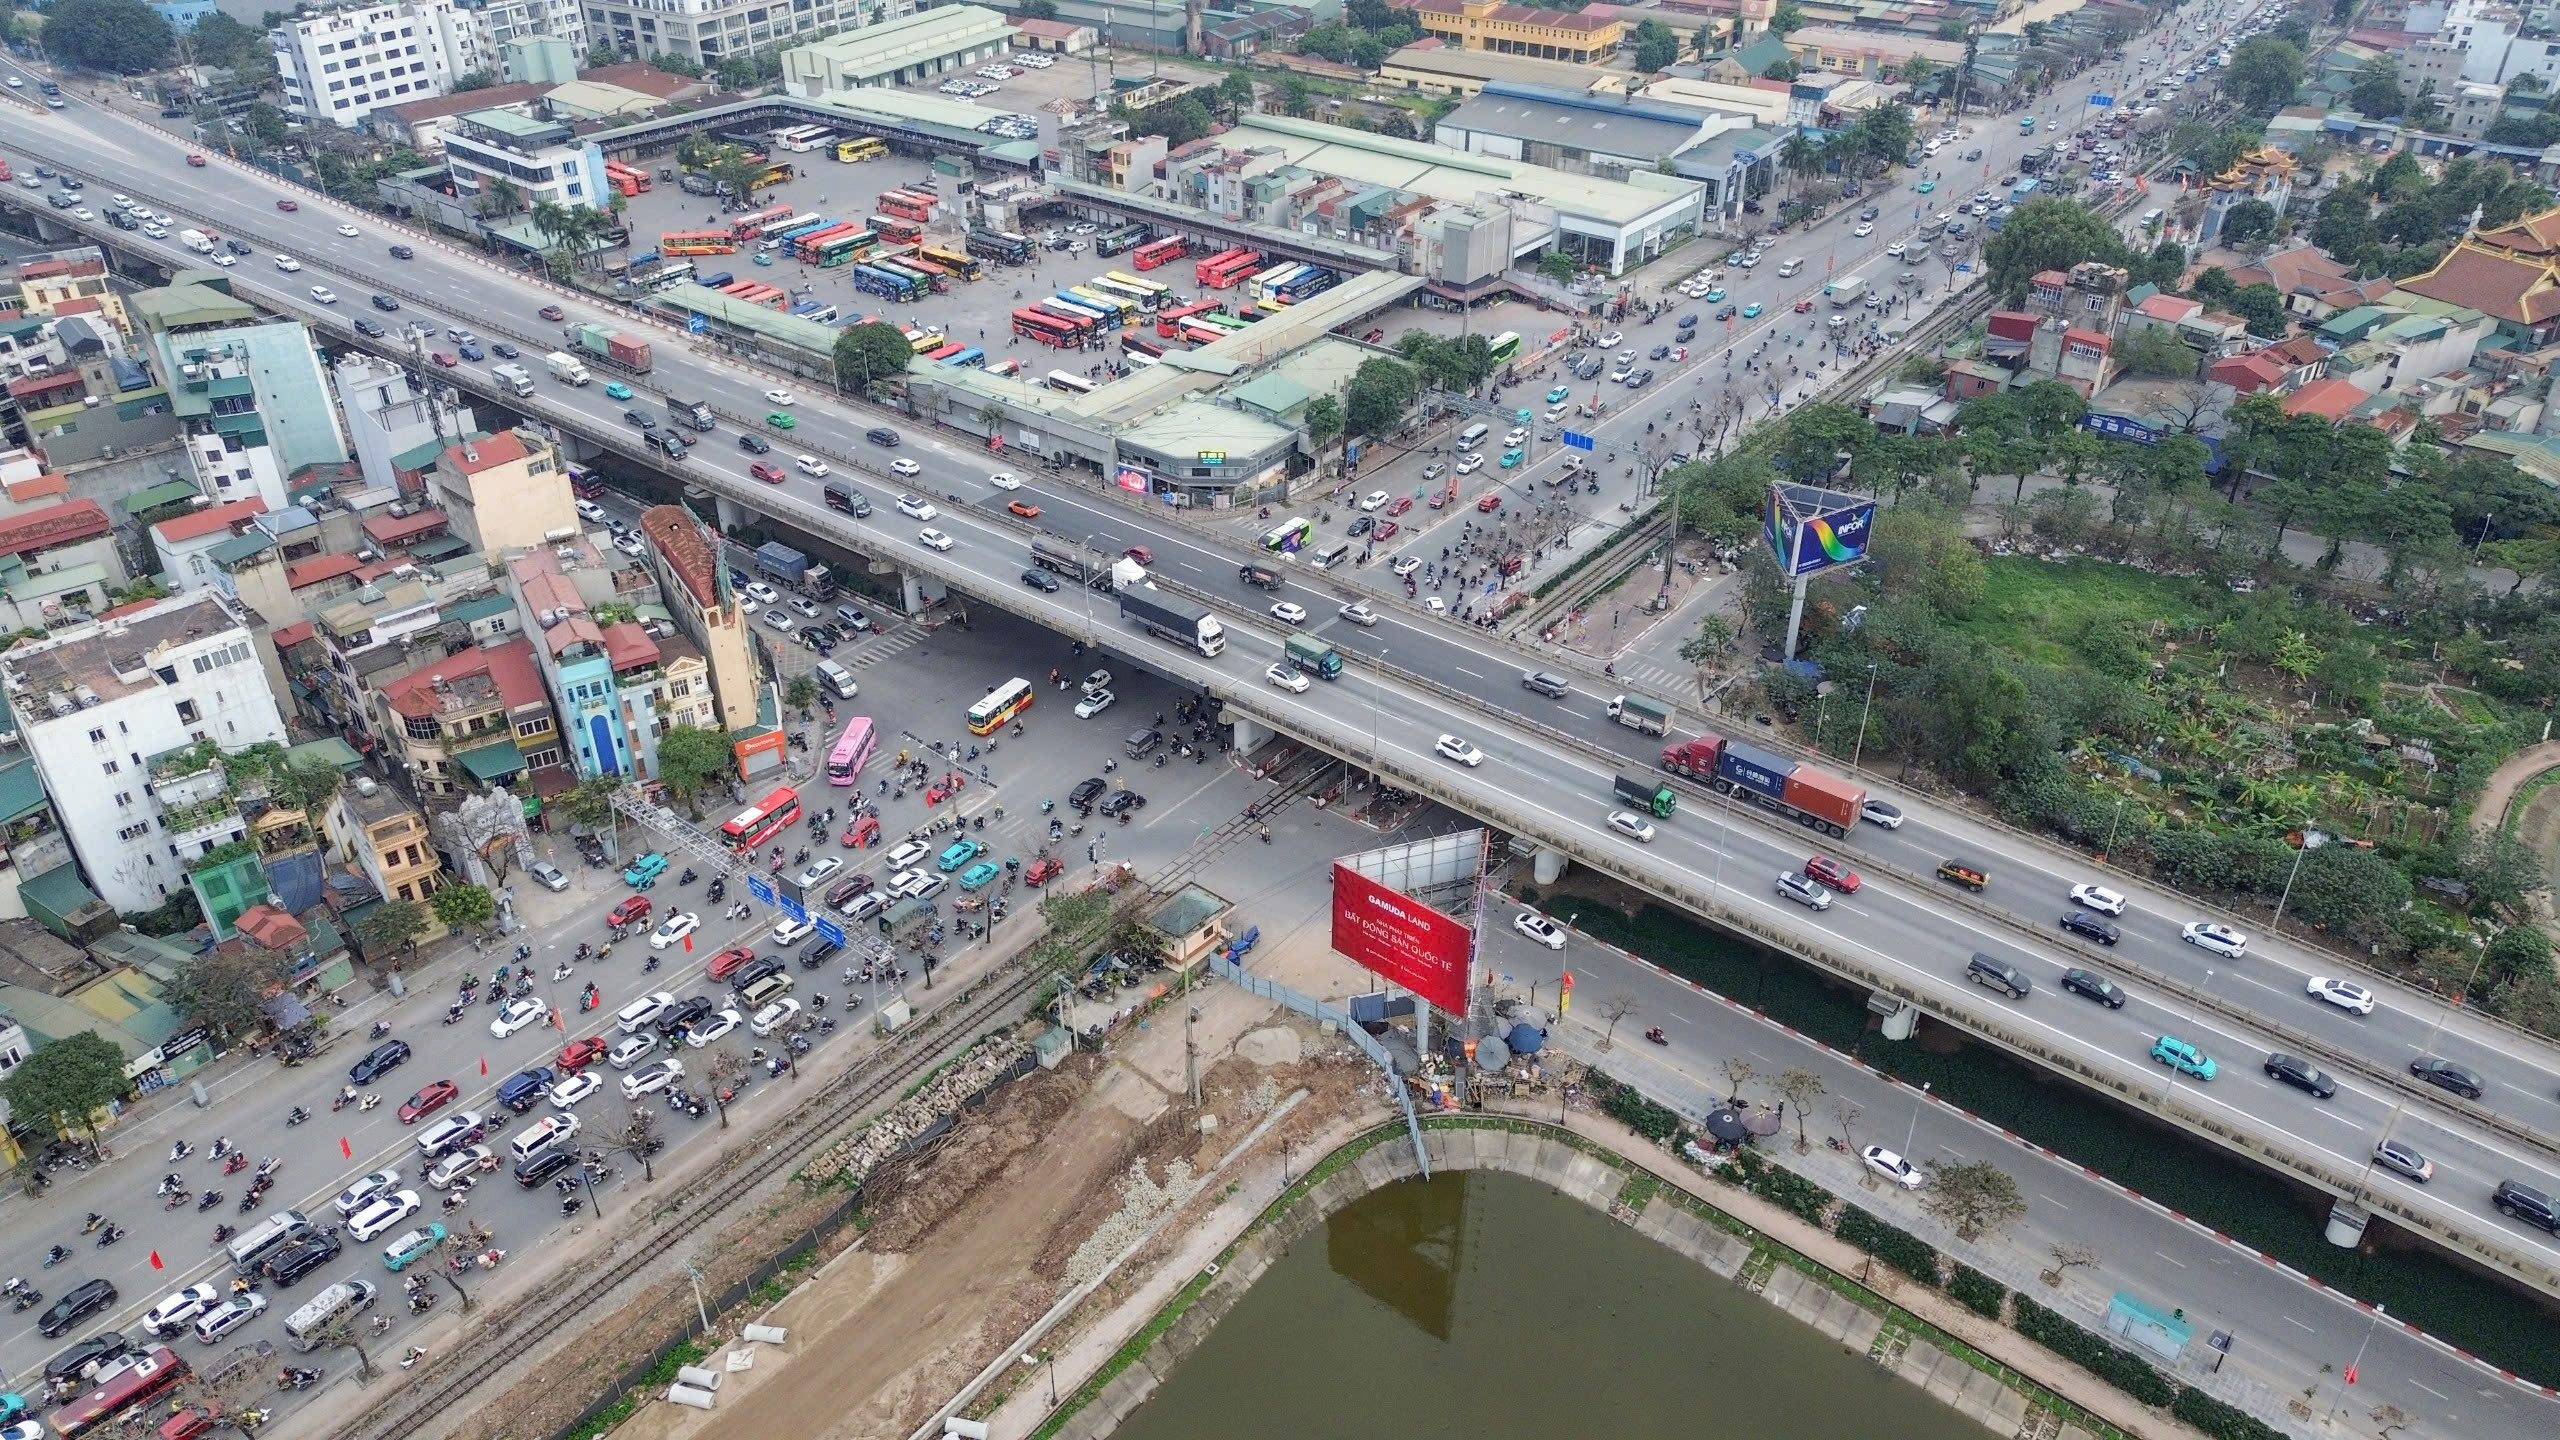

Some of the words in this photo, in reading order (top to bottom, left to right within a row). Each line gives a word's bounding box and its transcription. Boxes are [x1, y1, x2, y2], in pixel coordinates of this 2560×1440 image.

[1368, 895, 1406, 920] GAMUDA
[1408, 914, 1431, 931] LAND
[1345, 910, 1360, 924] BẤT
[1391, 934, 1409, 950] SẢN
[1411, 945, 1438, 965] QUỐC
[1441, 960, 1453, 972] TẾ
